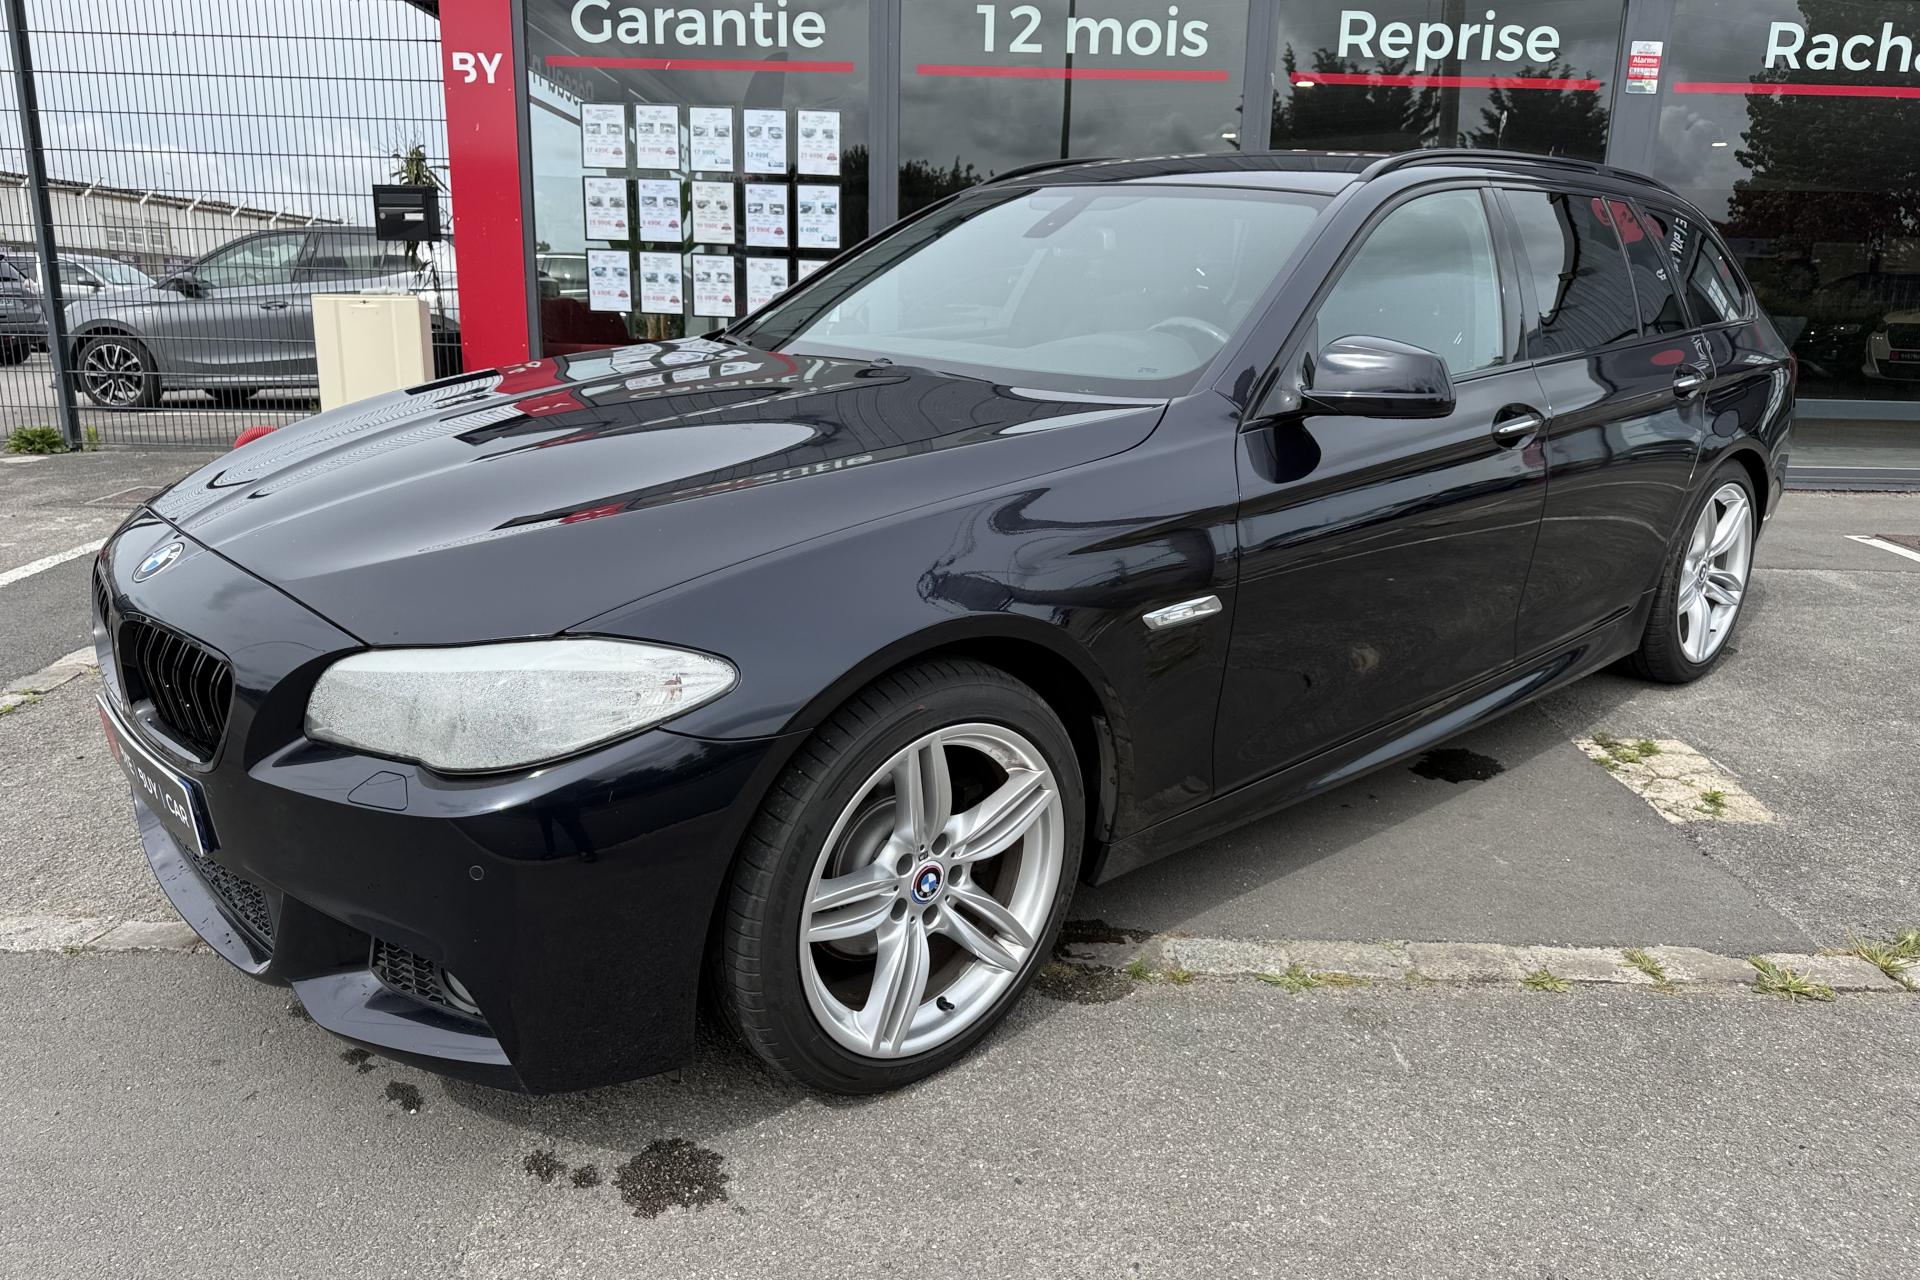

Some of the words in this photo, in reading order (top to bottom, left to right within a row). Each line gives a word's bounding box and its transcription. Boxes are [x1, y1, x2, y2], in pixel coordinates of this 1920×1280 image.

[570, 0, 826, 48] Garantie
[976, 4, 1043, 53] 12
[1066, 5, 1209, 57] mois
[1337, 9, 1560, 72] Reprise
[451, 51, 503, 84] BY
[1632, 56, 1658, 64] Alarme
[165, 793, 190, 828] CAR
